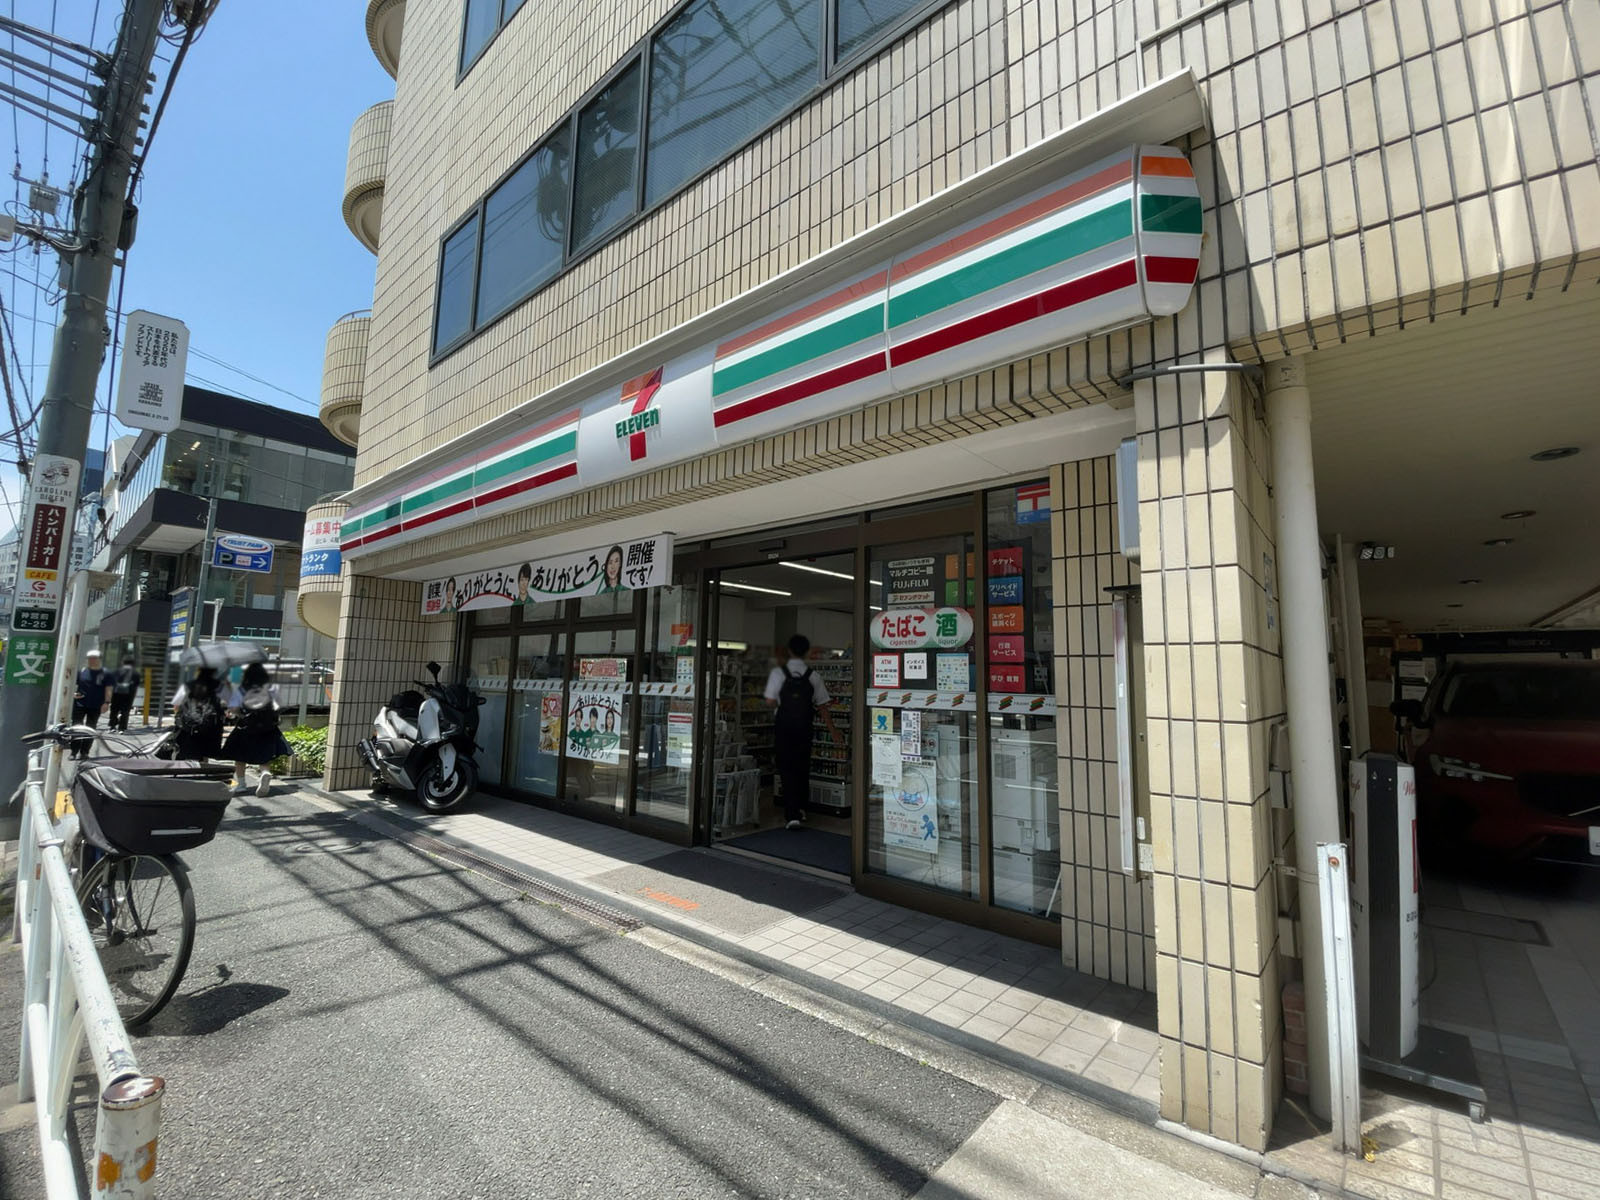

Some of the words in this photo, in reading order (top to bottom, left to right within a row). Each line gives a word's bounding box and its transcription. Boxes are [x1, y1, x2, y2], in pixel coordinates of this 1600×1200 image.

[35, 486, 72, 498] CAROLINE
[42, 508, 60, 566] ハンバーガー
[627, 540, 656, 567] 開催
[532, 554, 599, 593] ありがとう
[20, 620, 47, 629] 2-25
[881, 614, 927, 638] たばこ
[935, 613, 958, 637] 酒
